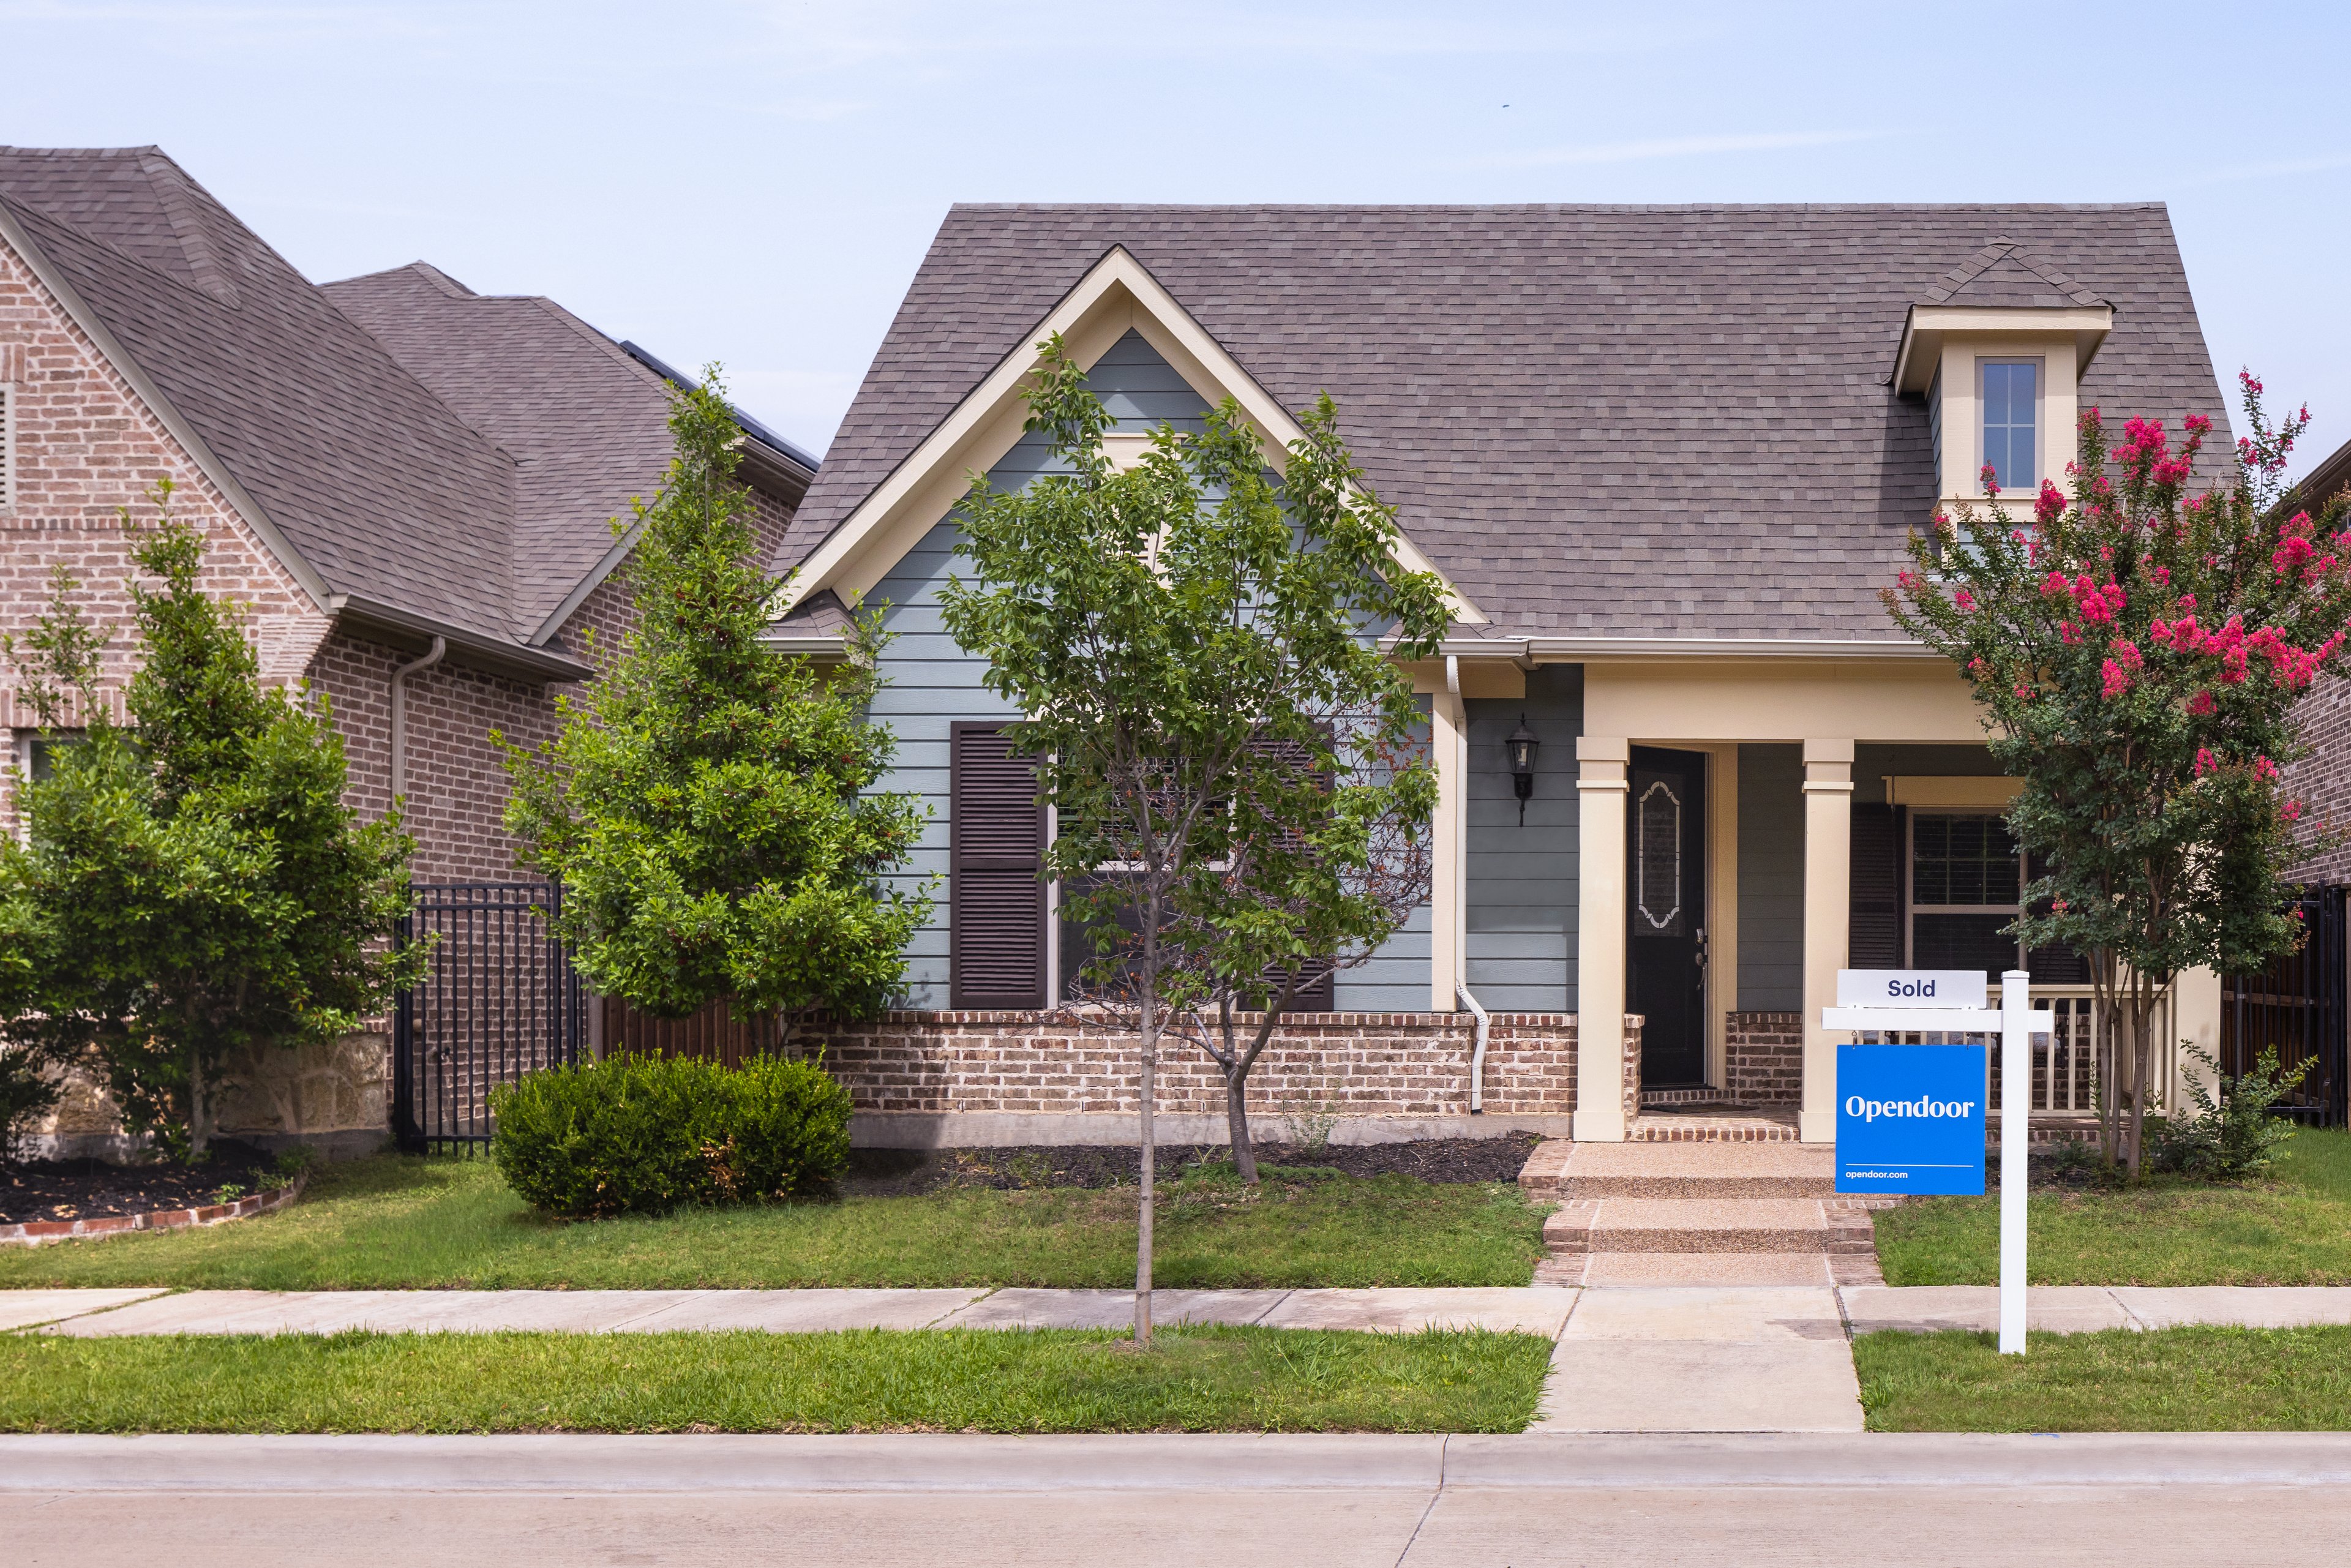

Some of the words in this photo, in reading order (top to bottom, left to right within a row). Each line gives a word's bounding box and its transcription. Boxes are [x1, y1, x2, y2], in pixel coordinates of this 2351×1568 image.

[1888, 980, 1935, 997] Sold
[1846, 1095, 1974, 1122] Opendoor
[1846, 1170, 1908, 1179] opendoor.com
